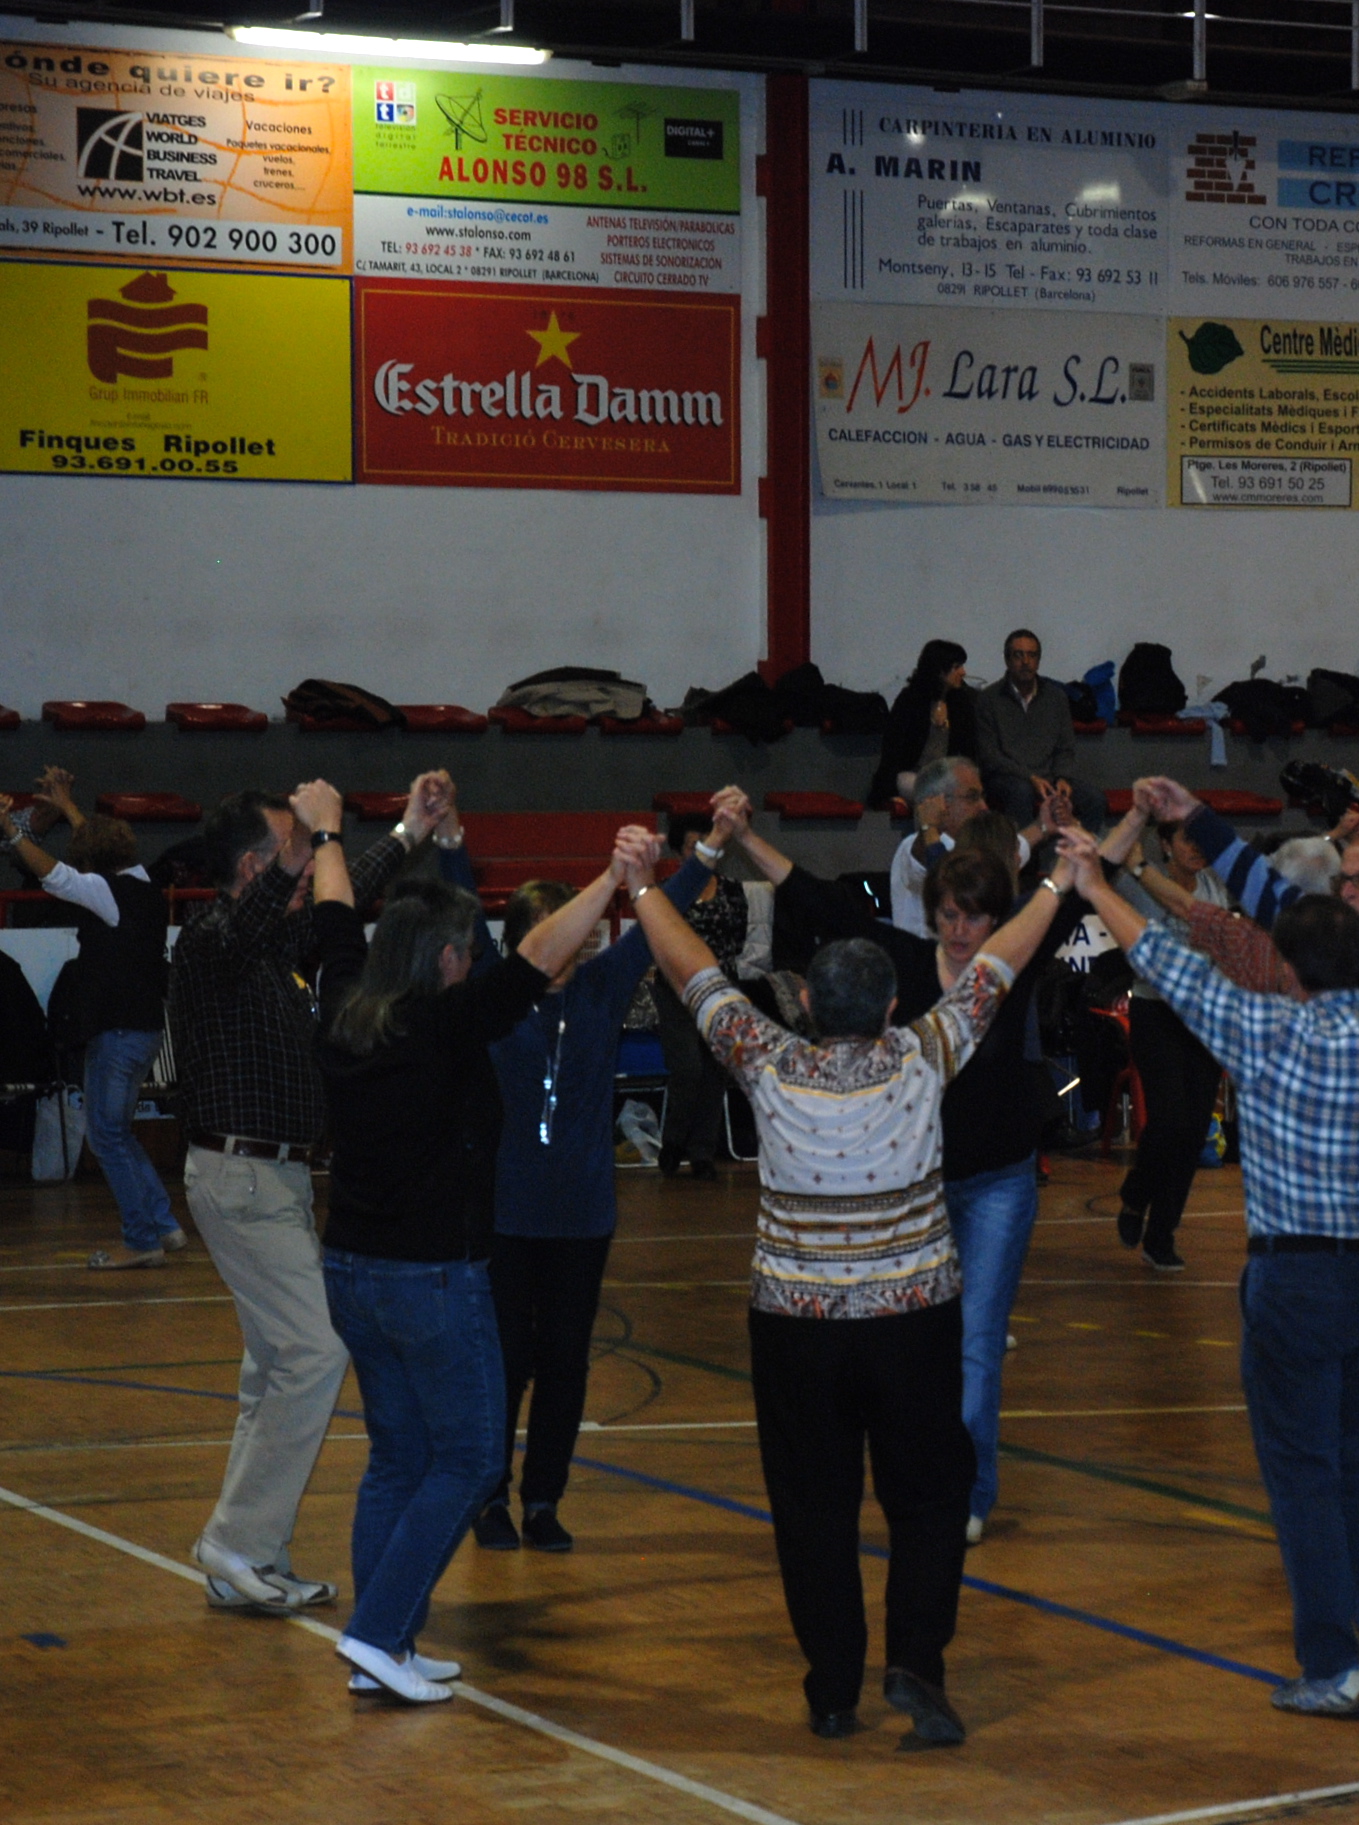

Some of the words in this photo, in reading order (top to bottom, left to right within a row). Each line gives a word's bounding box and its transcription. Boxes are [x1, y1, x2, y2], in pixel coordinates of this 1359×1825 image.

[29, 72, 59, 86] Su
[66, 78, 151, 95] agencia
[160, 85, 186, 98] de
[194, 86, 255, 103] viajes
[130, 65, 265, 88] quiere
[285, 74, 335, 93] ir?
[147, 112, 206, 127] VIATGES
[246, 121, 312, 135] Vacaciones
[494, 108, 598, 131] SERVICIO
[147, 131, 197, 145] WORLD
[502, 129, 597, 155] TÉCNICO
[1027, 127, 1051, 142] EN
[1061, 130, 1156, 149] ALUMINIO
[147, 151, 217, 165] BUSINESS
[827, 153, 855, 174] A.
[875, 156, 982, 182] MARIN
[147, 169, 202, 182] TRAVEL
[438, 156, 546, 186] ALONSO
[556, 163, 587, 189] 98
[598, 165, 647, 192] S.L.
[77, 184, 216, 205] www.wbt.es
[1065, 203, 1156, 222] Cubrimientos
[426, 226, 531, 241] www.stalonso.com
[986, 218, 1070, 236] Escaparates
[1088, 224, 1118, 238] toda
[1123, 226, 1157, 239] clase
[1250, 216, 1287, 229] CON
[1292, 218, 1339, 232] TODA
[23, 220, 38, 233] 39
[43, 222, 88, 237] Ripollet
[112, 222, 156, 246] Tel.
[168, 225, 216, 249] 902
[229, 228, 277, 252] 900
[289, 232, 335, 255] 300
[917, 233, 935, 246] de
[940, 235, 998, 251] trabajos
[1006, 238, 1022, 251] en
[1031, 238, 1092, 255] aluminio.
[405, 242, 419, 255] 93
[422, 243, 441, 256] 692
[443, 244, 458, 257] 45
[509, 248, 522, 260] 93
[525, 248, 544, 261] 692
[542, 268, 599, 283] (BARCELONA)
[614, 272, 653, 284] CIRCUITO
[879, 258, 953, 279] Montseny,
[1076, 267, 1092, 283] 93
[1097, 268, 1120, 284] 692
[1126, 270, 1141, 284] 53
[974, 285, 1028, 298] RIPOLLET
[1035, 287, 1096, 302] (Barcelona)
[1260, 325, 1315, 355] Centre
[943, 350, 1039, 400] Lara
[1054, 354, 1126, 407] S.L.
[374, 358, 563, 419] Estrella
[571, 372, 723, 427] Damm
[1190, 386, 1255, 400] Accidents
[1259, 387, 1319, 403] Laborals,
[1190, 404, 1273, 418] Especialitats
[1190, 421, 1256, 434] Certificats
[20, 430, 135, 453] Finques
[164, 434, 275, 457] Ripollet
[828, 429, 927, 444] CALEFACCION
[945, 432, 986, 446] AGUA
[1003, 433, 1032, 448] GAS
[1047, 435, 1149, 450] ELECTRICIDAD
[1190, 437, 1251, 451] Permisos
[52, 455, 238, 473] 93.691.00.55
[1300, 461, 1347, 475] (Ripollet)
[1211, 476, 1234, 490] Tel.
[1238, 476, 1255, 490] 93
[1258, 477, 1283, 490] 691
[1288, 477, 1304, 490] 50
[1308, 477, 1325, 490] 25
